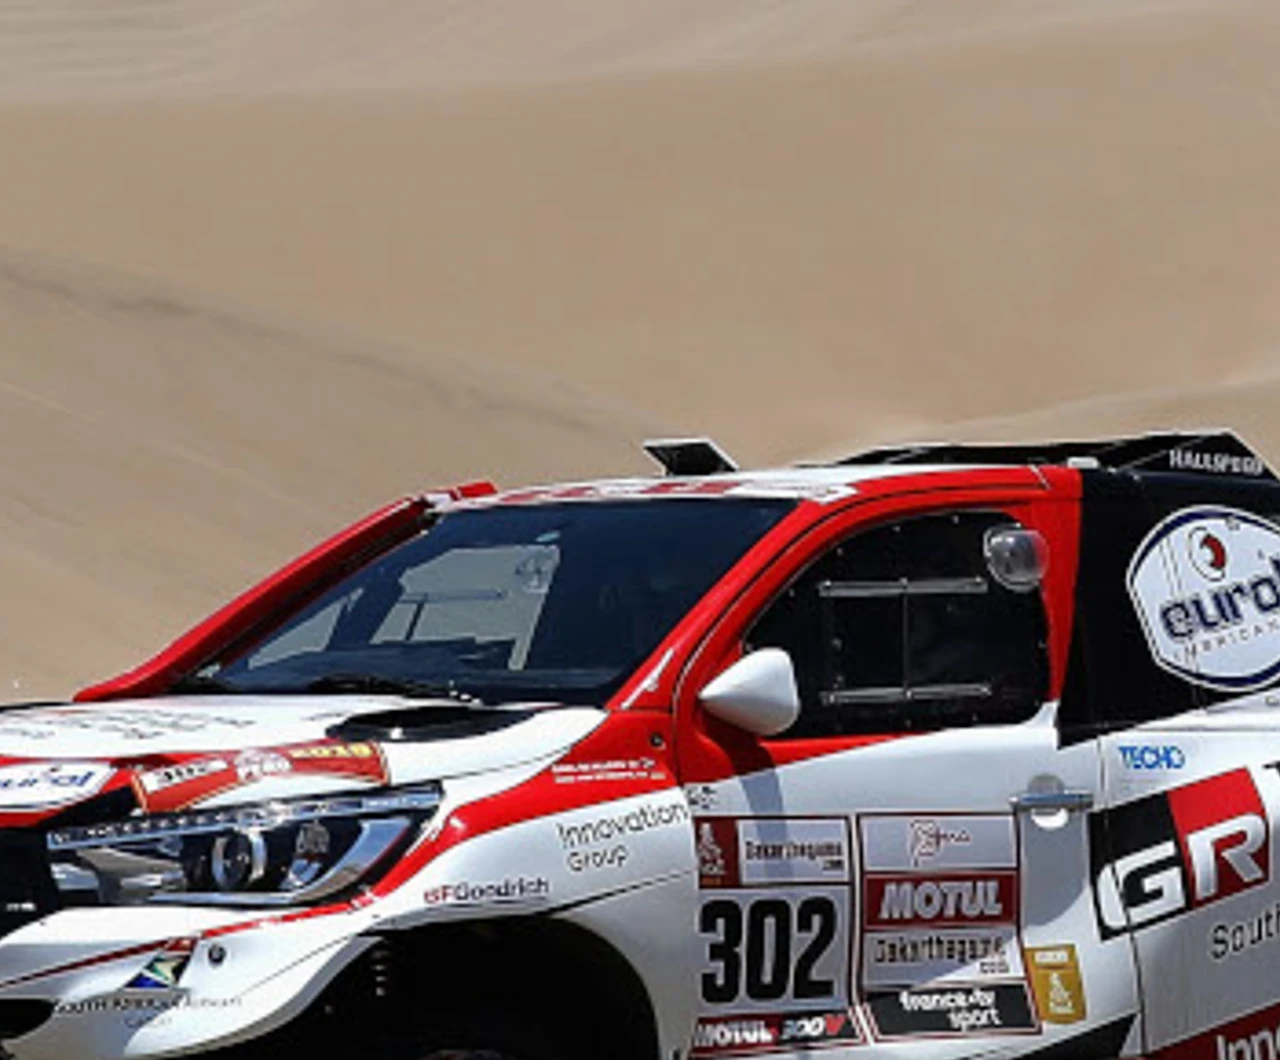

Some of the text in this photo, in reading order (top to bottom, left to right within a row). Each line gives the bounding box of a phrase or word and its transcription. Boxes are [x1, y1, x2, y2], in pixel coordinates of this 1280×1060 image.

[557, 801, 690, 849] Innovation
[569, 845, 628, 872] Group
[1096, 812, 1267, 930] GR
[878, 880, 1003, 920] MOTUL
[700, 897, 838, 1003] 302
[694, 1021, 773, 1047] MOTUL
[947, 1005, 1003, 1030] sport
